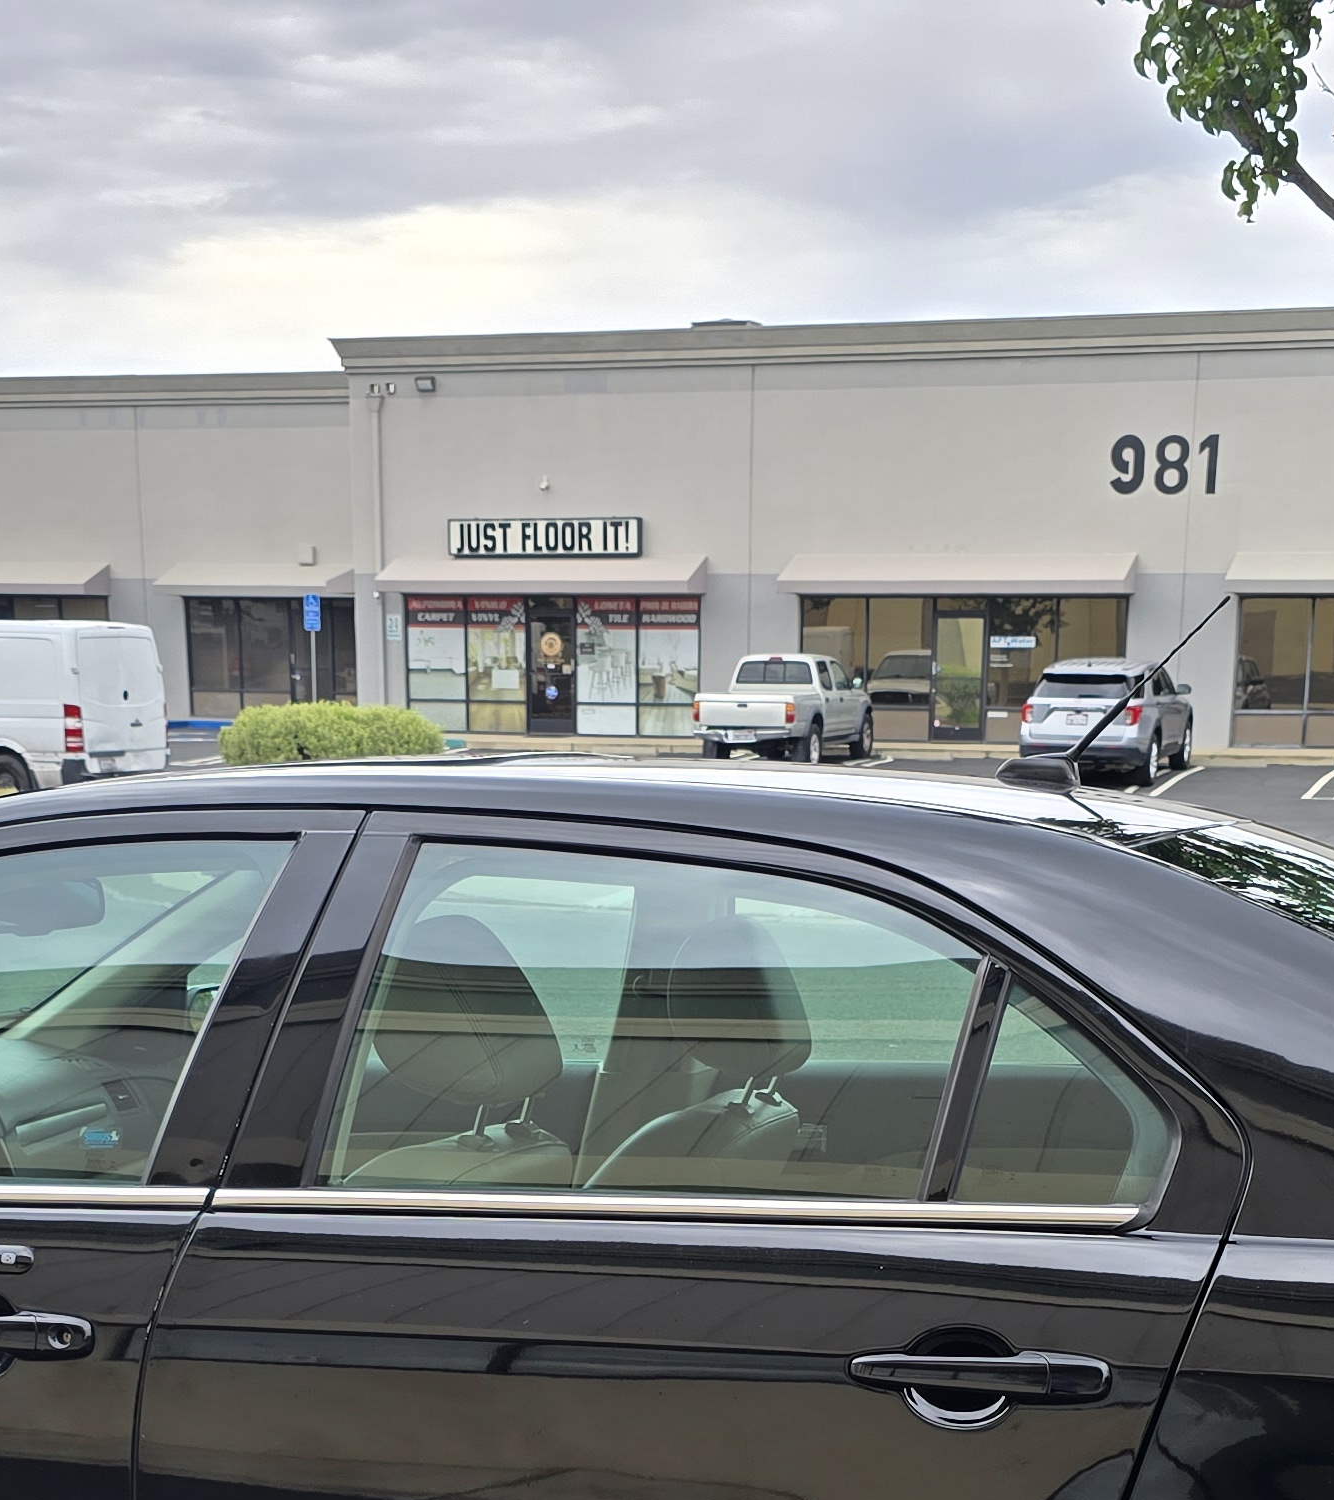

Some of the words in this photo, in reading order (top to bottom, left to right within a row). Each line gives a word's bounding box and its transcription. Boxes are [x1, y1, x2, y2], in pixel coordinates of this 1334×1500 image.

[1109, 433, 1220, 495] 981
[457, 522, 511, 553] JUST
[521, 521, 593, 552] FLOOR
[602, 520, 630, 552] IT!
[417, 612, 455, 621] CARPET
[608, 613, 630, 623] TILE
[641, 613, 698, 623] HARDWOOD
